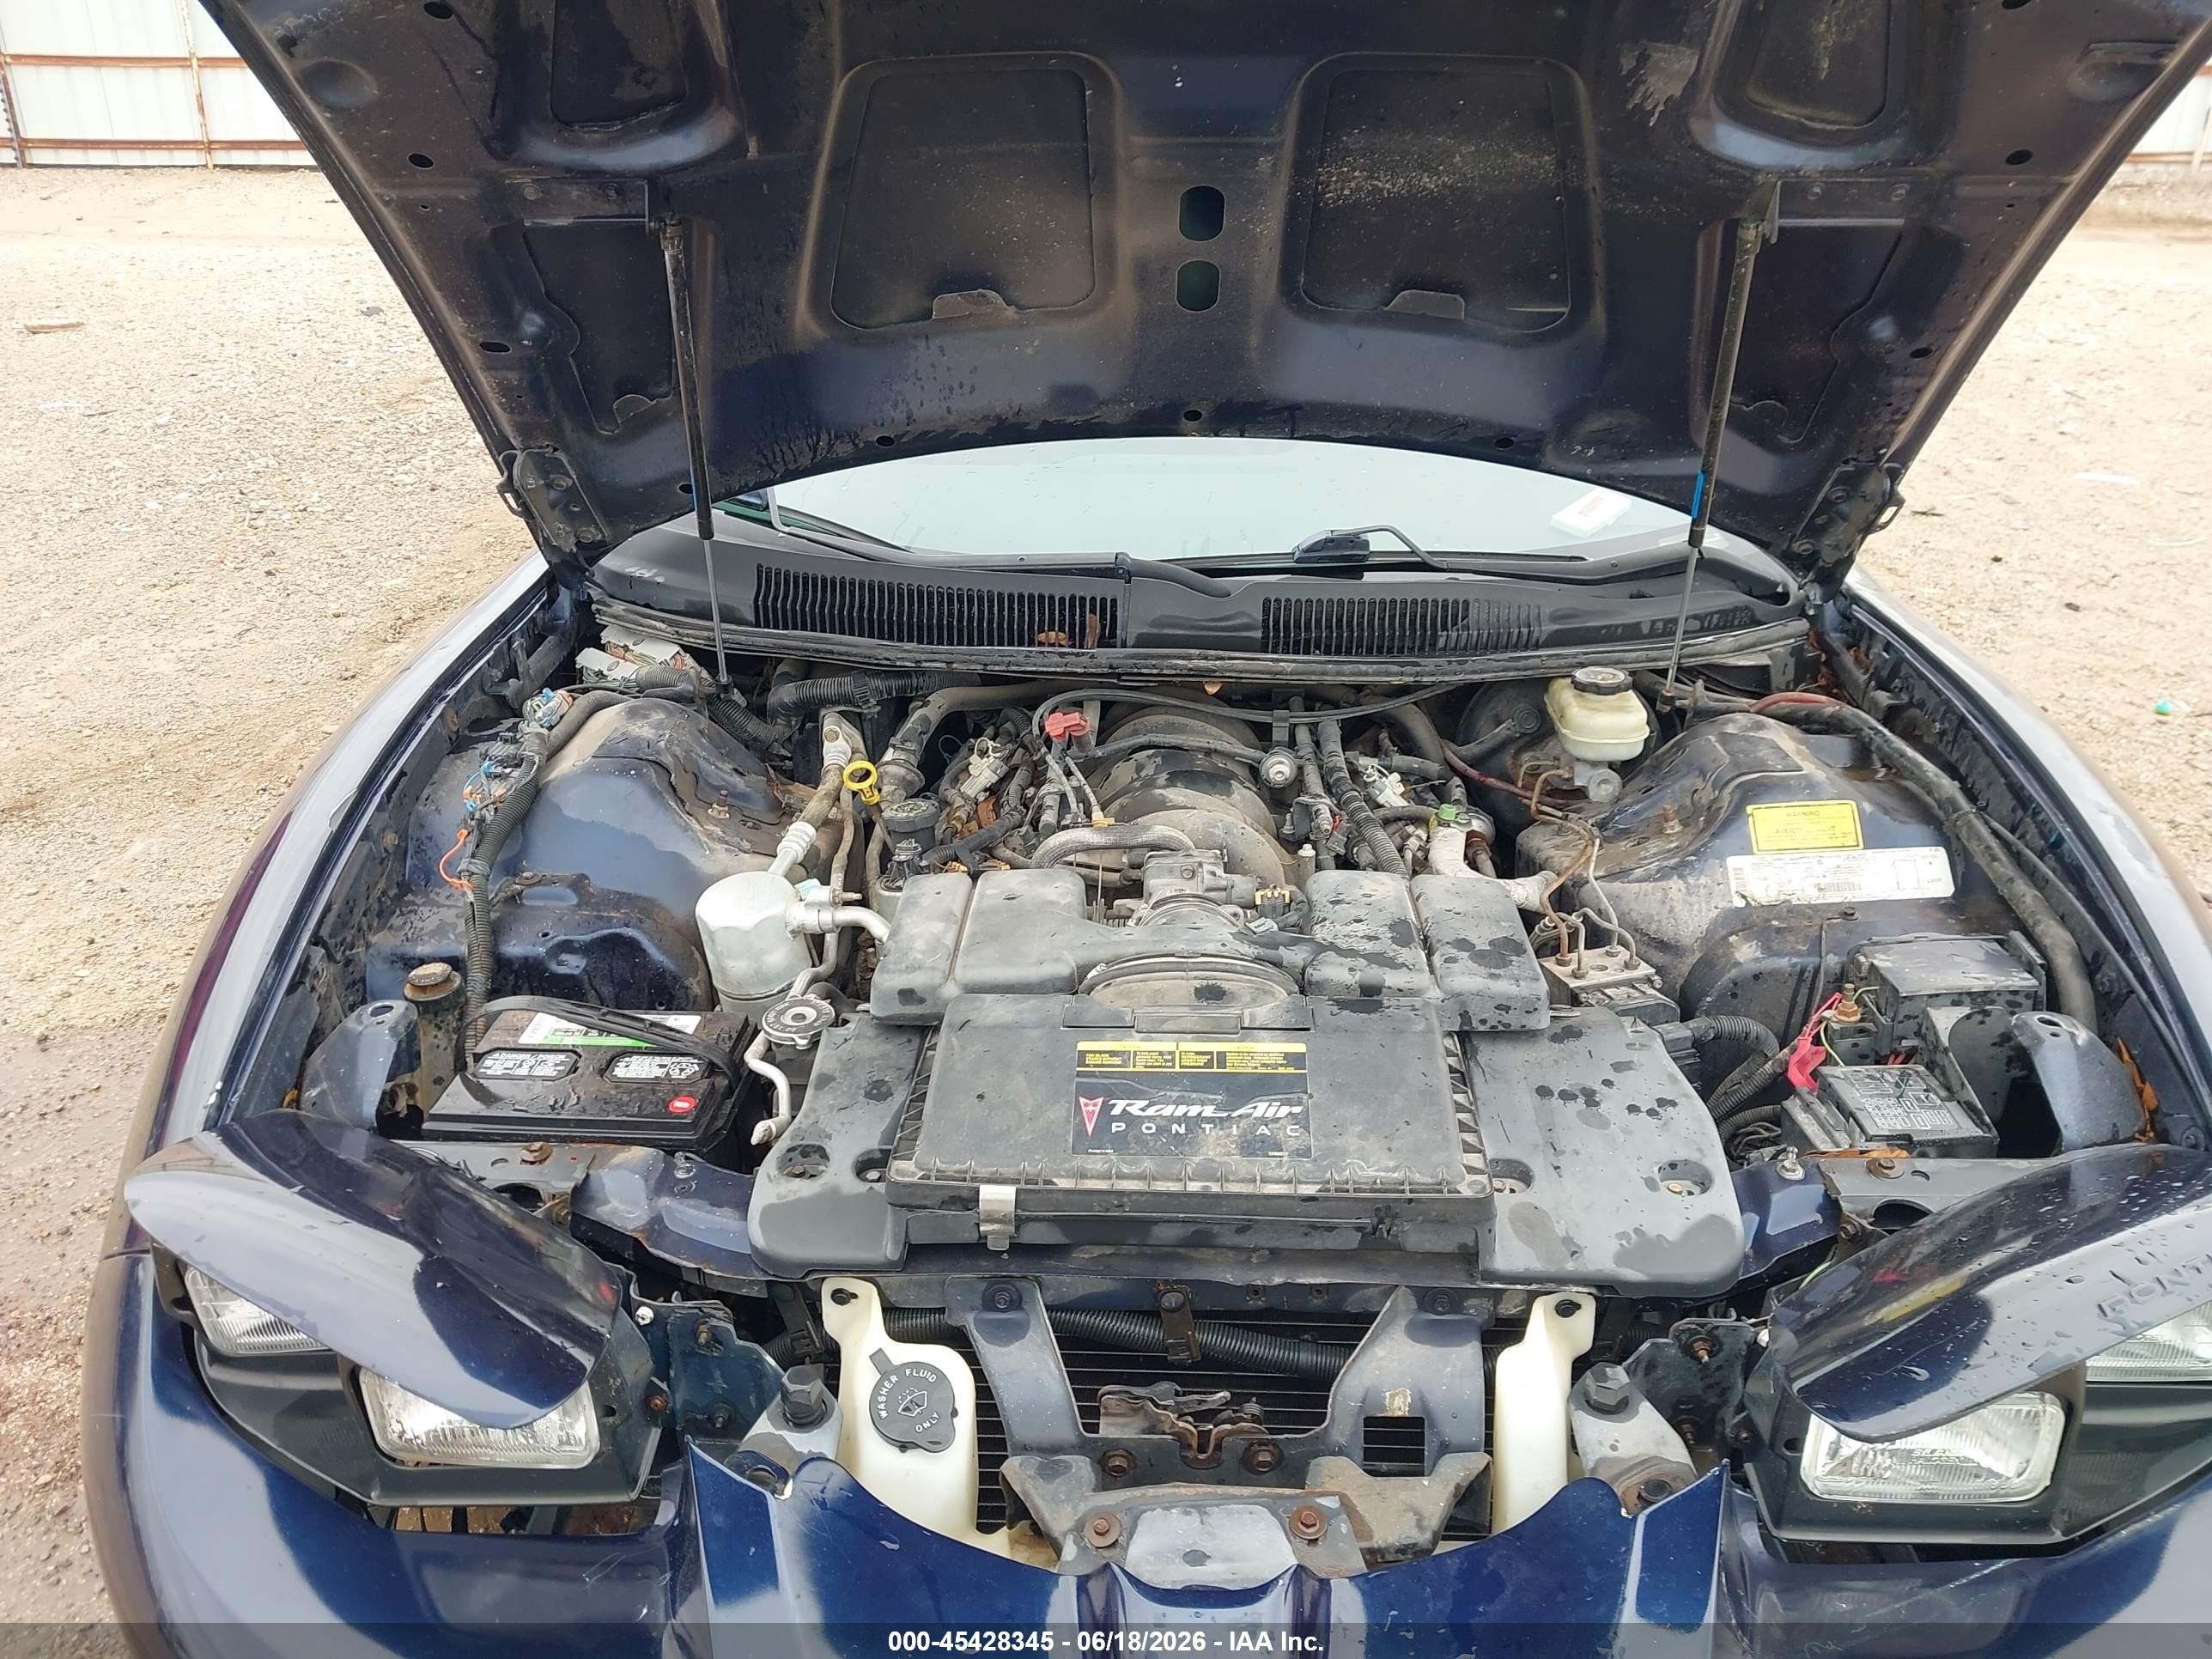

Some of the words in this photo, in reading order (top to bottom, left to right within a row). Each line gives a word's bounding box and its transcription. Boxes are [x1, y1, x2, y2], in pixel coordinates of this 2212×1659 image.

[1108, 1099, 1229, 1117] Ram
[1231, 1102, 1304, 1118] Air
[1111, 1121, 1300, 1136] PONTIAC
[877, 1374, 899, 1420] WASHER
[905, 1368, 938, 1383] FLUID
[915, 1411, 941, 1433] ONLY
